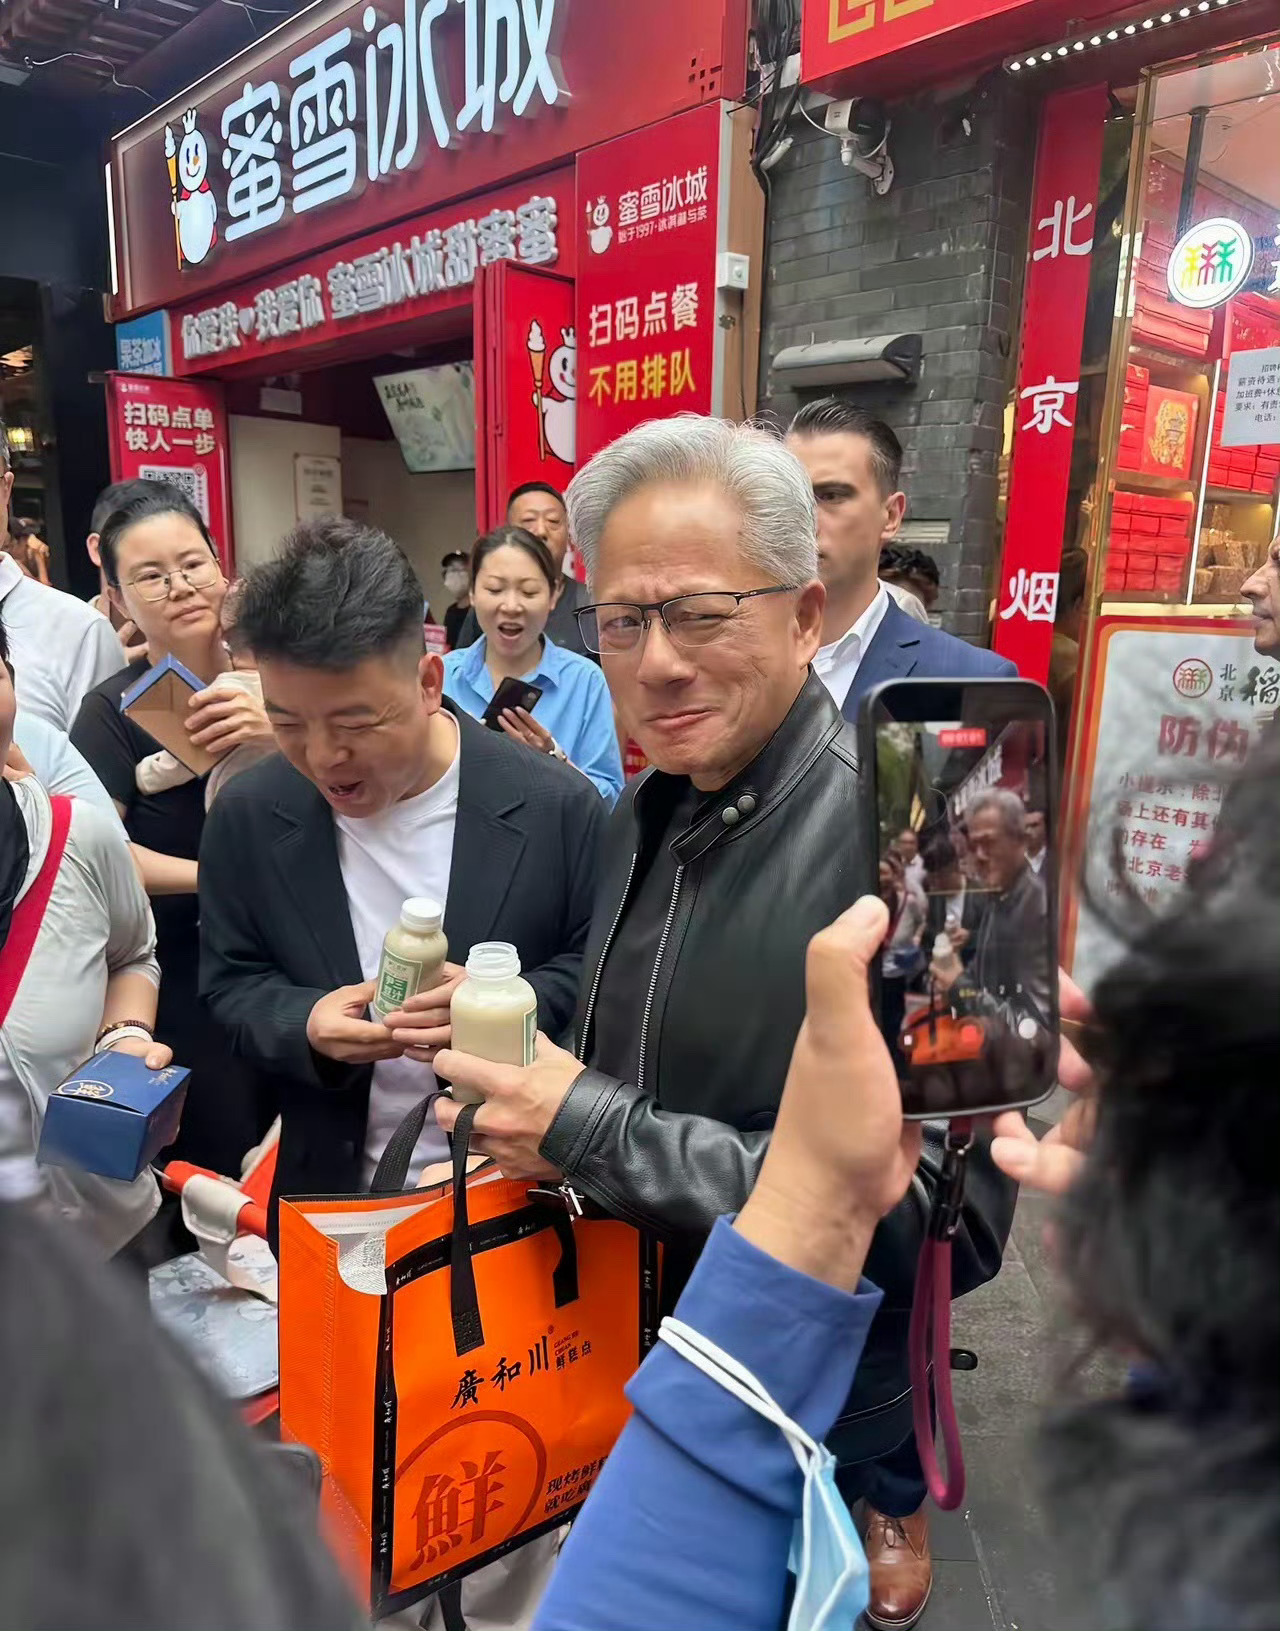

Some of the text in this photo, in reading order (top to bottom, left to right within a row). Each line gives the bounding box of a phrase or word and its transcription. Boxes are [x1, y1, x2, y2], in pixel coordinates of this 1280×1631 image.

[220, 0, 559, 242] 蜜雪冰城
[618, 165, 708, 227] 蜜雪冰城
[327, 195, 559, 320] 蜜雪冰城甜蜜蜜
[588, 281, 699, 348] 扫码点餐
[588, 347, 697, 407] 不用排队
[1234, 399, 1280, 412] 要求：有责
[124, 400, 215, 430] 扫码点单
[125, 427, 215, 455] 快人一步
[1217, 663, 1238, 702] 北京
[450, 1335, 549, 1410] 廣和川
[409, 1449, 507, 1572] 鮮
